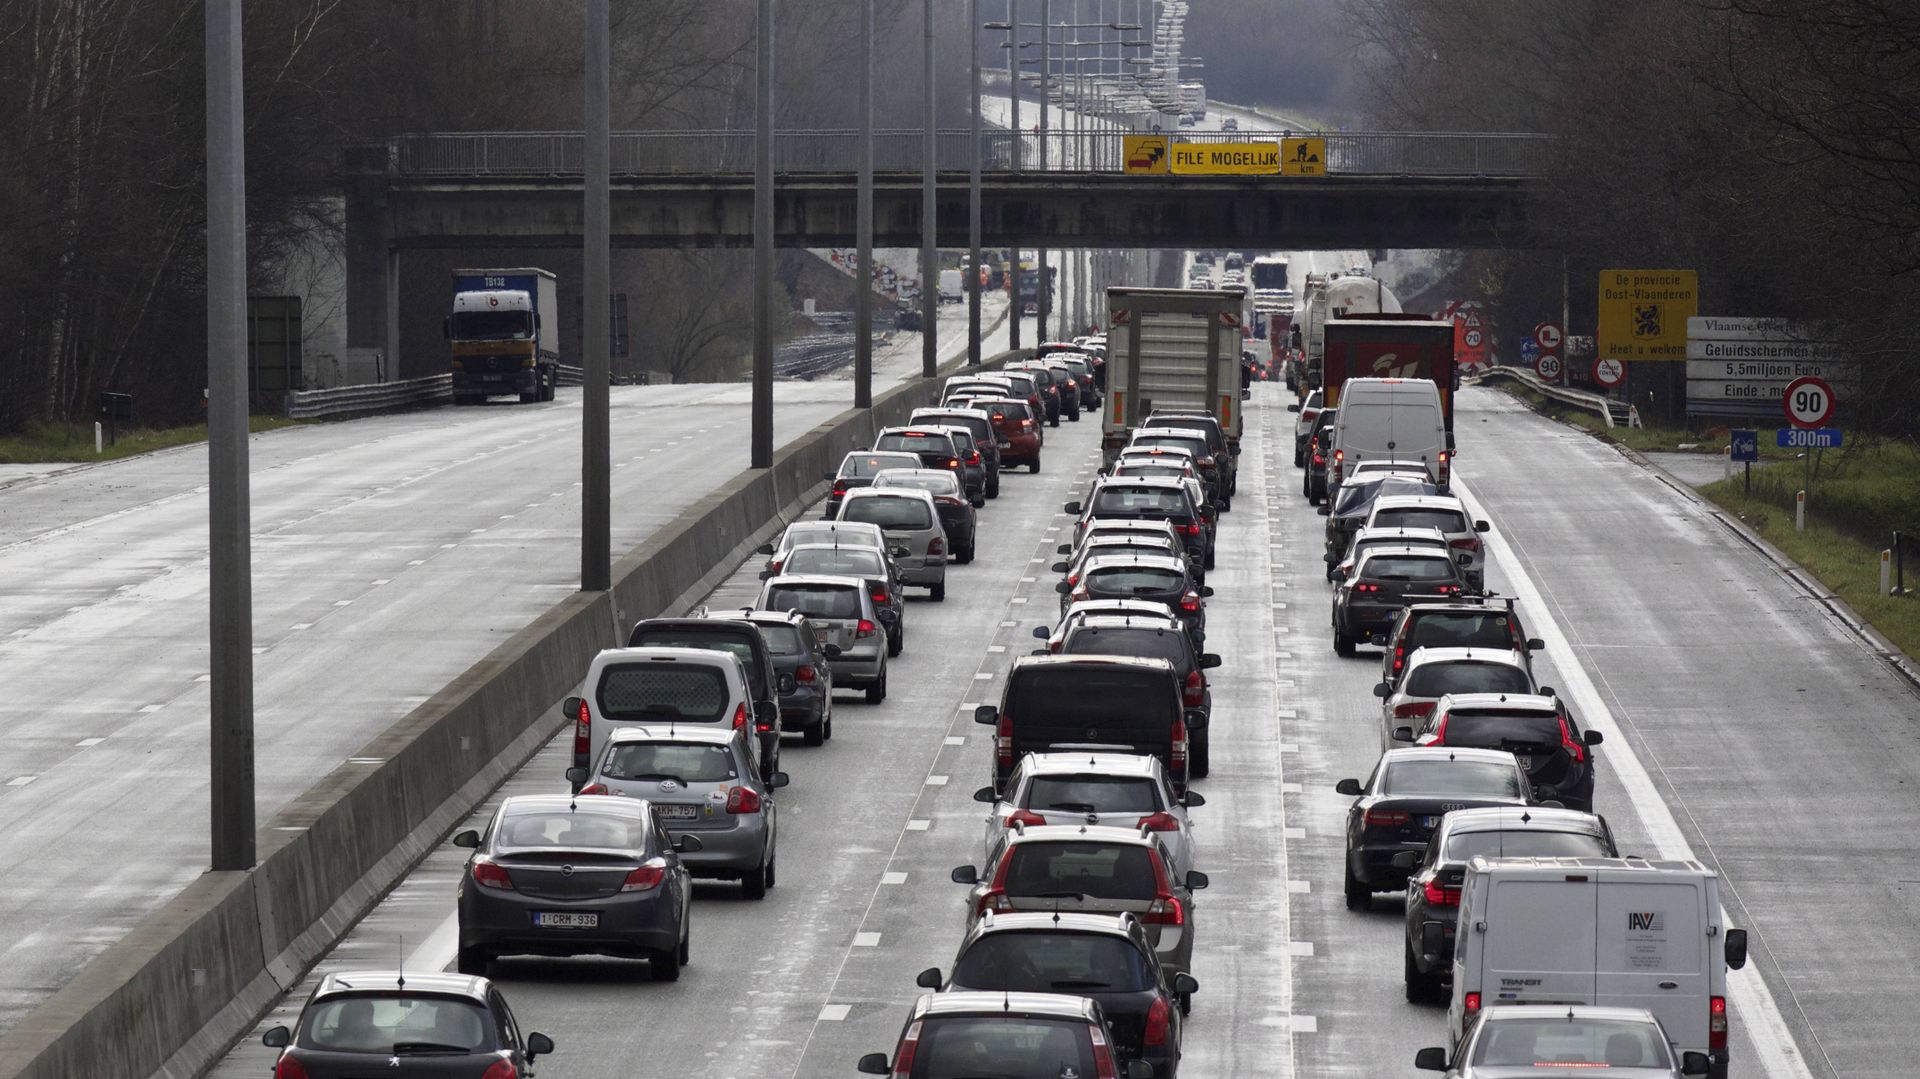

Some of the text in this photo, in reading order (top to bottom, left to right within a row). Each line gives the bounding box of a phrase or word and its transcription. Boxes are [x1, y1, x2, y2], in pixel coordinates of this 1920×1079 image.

[1177, 152, 1278, 166] FILE MOGELIJK
[1300, 164, 1315, 174] km
[1616, 274, 1681, 288] De provincie
[1605, 289, 1691, 300] Oost-Vlaanderen
[1705, 320, 1752, 332] Vlaamse
[1468, 334, 1479, 343] 70
[1610, 344, 1686, 354] Heet u welkom
[1705, 343, 1808, 358] Geluidsschermen
[1541, 360, 1559, 373] 90
[1726, 362, 1821, 377] 5,5miljoen Euro
[1725, 384, 1758, 397] Einde
[1796, 391, 1821, 413] 90
[1787, 431, 1831, 447] 300m
[1628, 912, 1655, 931] IAV
